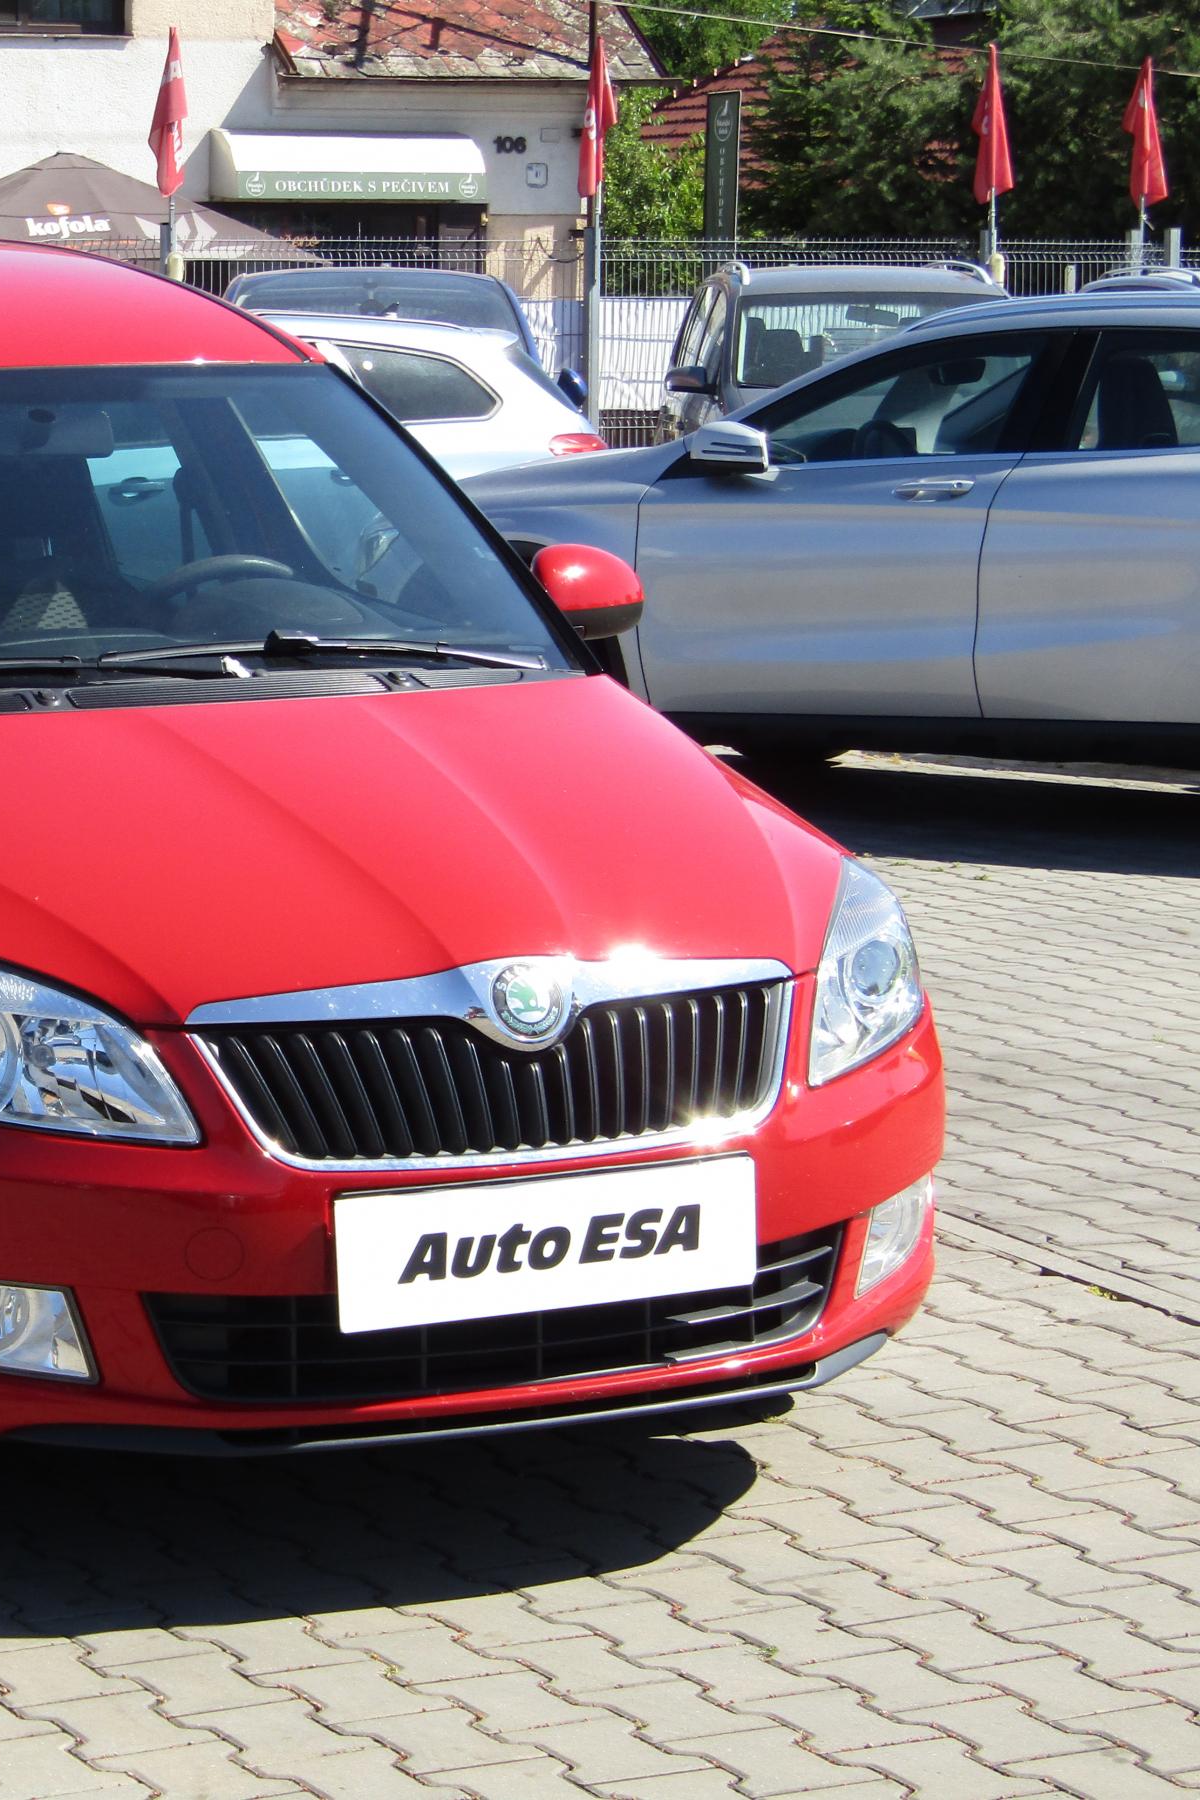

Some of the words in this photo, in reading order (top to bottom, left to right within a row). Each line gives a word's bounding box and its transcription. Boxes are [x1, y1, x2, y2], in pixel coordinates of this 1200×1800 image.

[493, 136, 527, 154] 106
[275, 177, 363, 193] OBCHŮDEK
[368, 180, 377, 193] S
[382, 178, 449, 194] PEČIVEM
[25, 215, 111, 239] kofola
[397, 1222, 571, 1284] Auto
[579, 1204, 701, 1264] ESA
